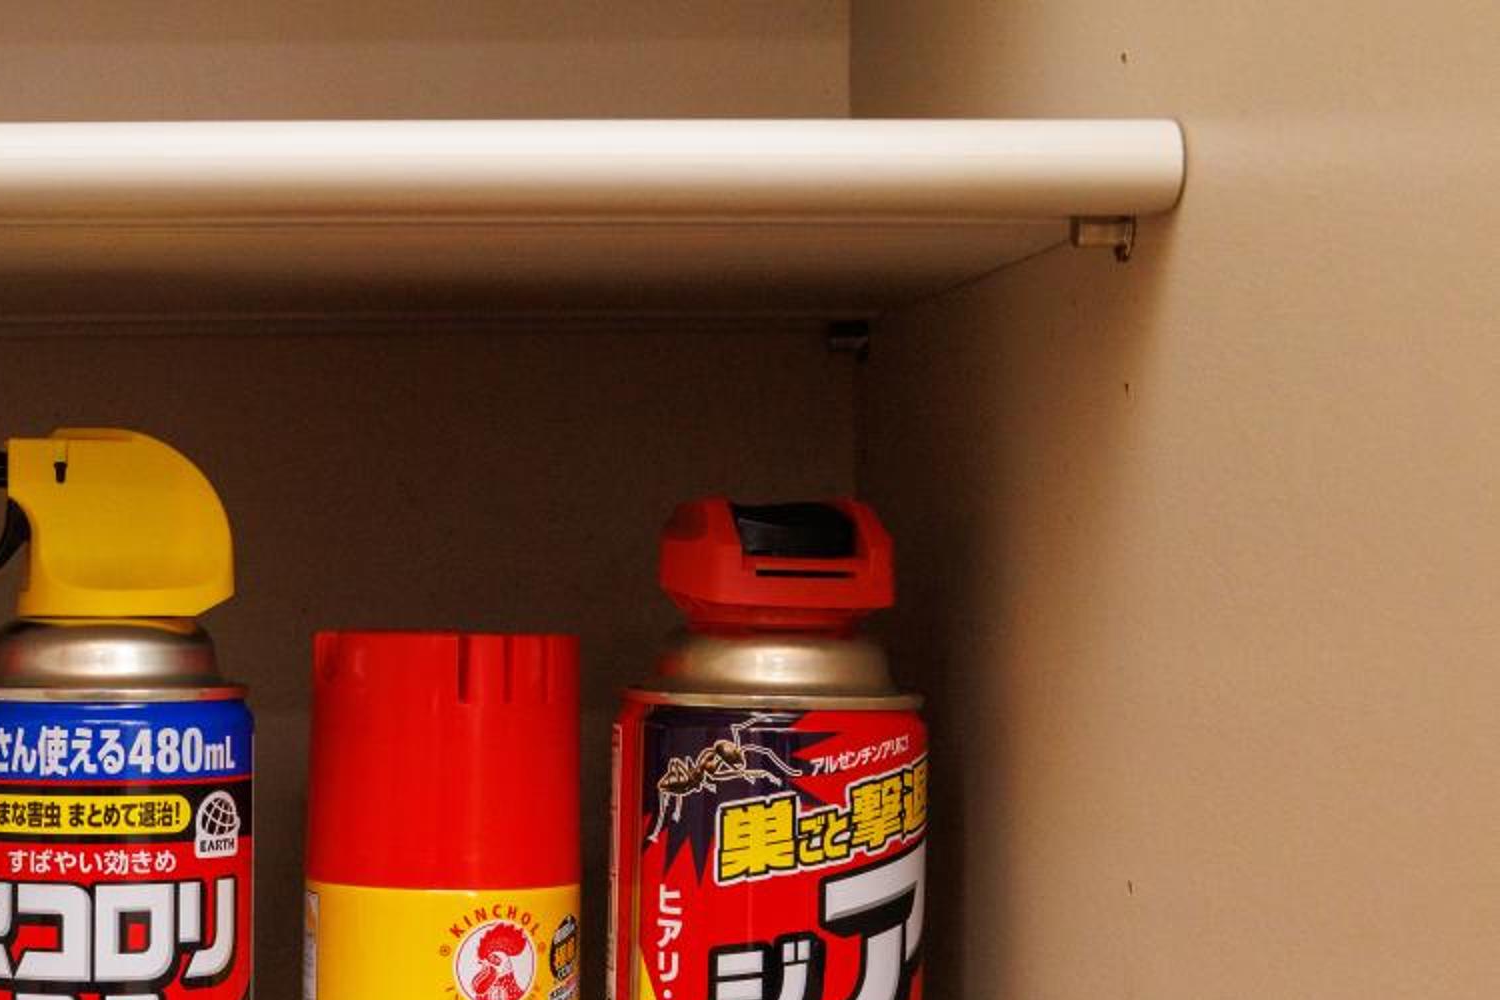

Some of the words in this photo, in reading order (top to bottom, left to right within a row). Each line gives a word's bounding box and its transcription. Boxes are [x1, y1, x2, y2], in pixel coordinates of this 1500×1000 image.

[201, 839, 235, 852] EARTH
[8, 850, 177, 875] すばやい効きめ
